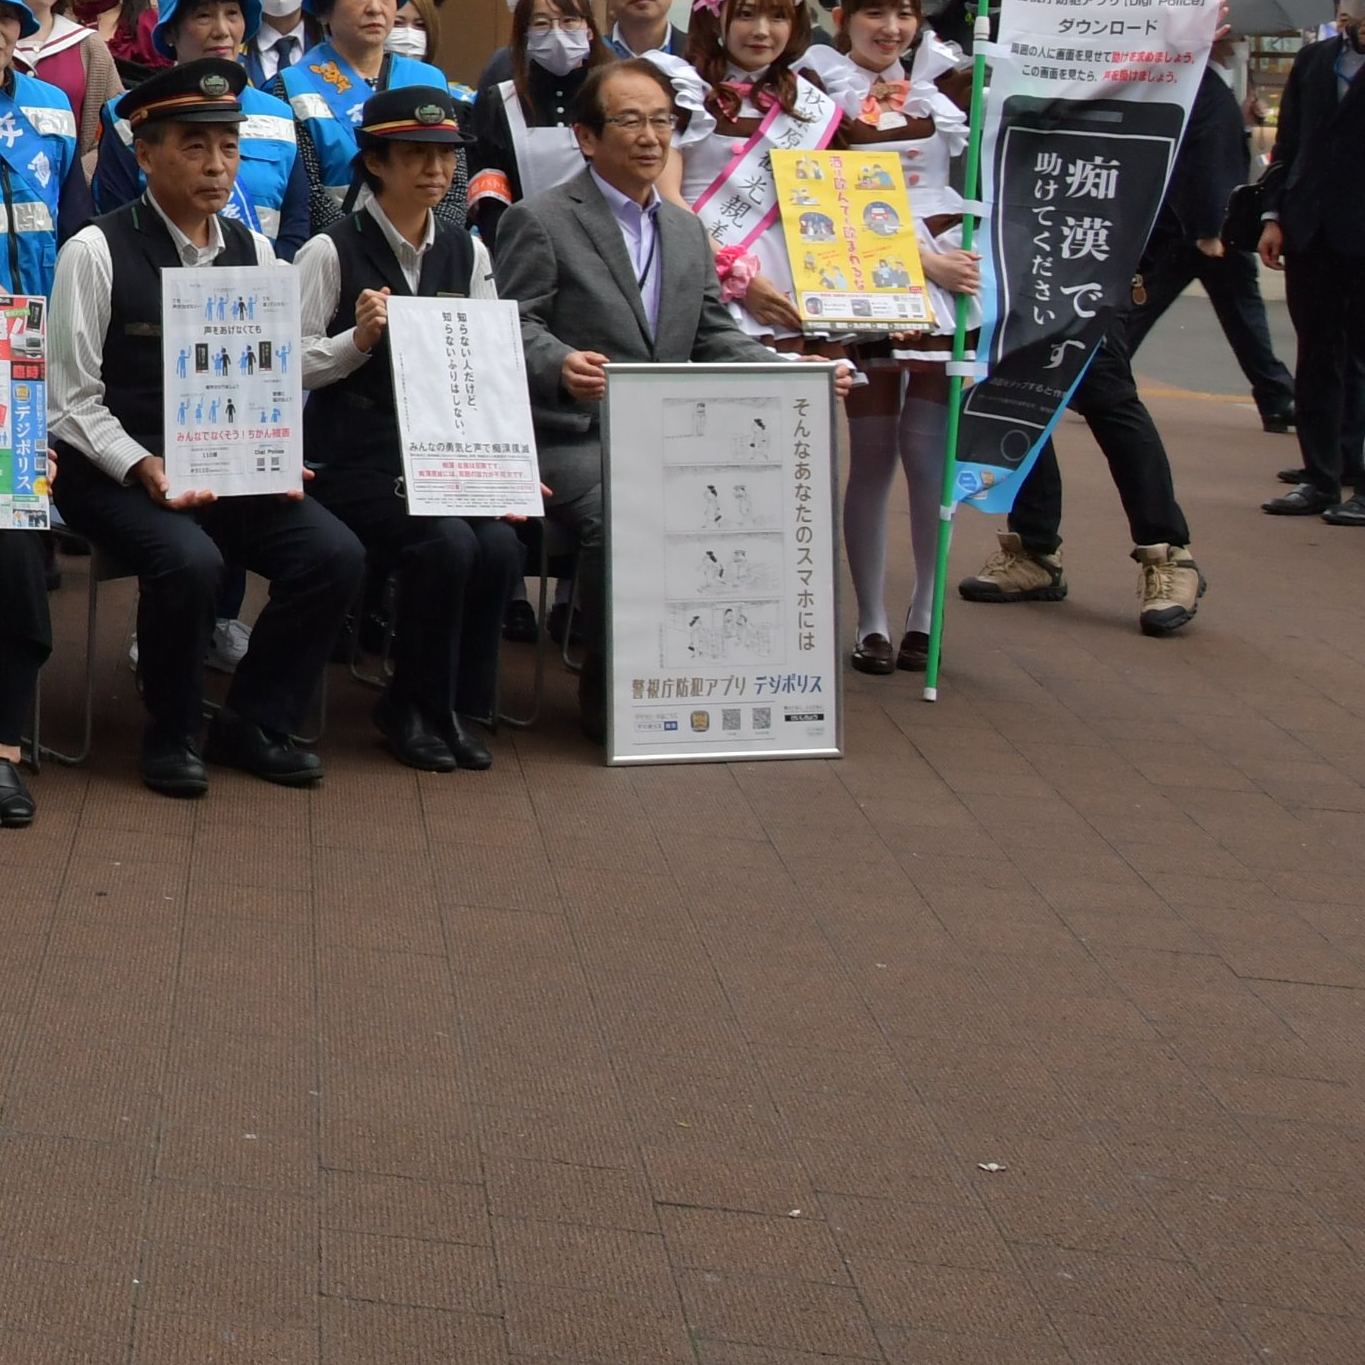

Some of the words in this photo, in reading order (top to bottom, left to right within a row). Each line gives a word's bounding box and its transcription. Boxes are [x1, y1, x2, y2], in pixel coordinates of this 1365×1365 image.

[1058, 18, 1158, 36] ダウンロード
[1010, 42, 1196, 64] 周囲の人に画面を見せて助けを求めましょう。
[1021, 65, 1179, 84] この画面を見たら、声を掛けましょう。
[1032, 151, 1063, 326] 助けてください
[1042, 155, 1121, 370] 痴漢です
[203, 325, 262, 335] 声をあげなくても
[442, 312, 466, 436] 知らないふりはしない。
[456, 312, 478, 412] 知らない人だけど、
[14, 405, 32, 491] デジポリス
[176, 430, 245, 442] みんなでなくそう!
[409, 442, 530, 454] みんなの勇気と声で痴漢撲滅
[792, 397, 816, 652] そんなあなたのスマホには
[632, 674, 747, 700] 警視庁防犯アプリ
[754, 672, 823, 695] デジポリス
